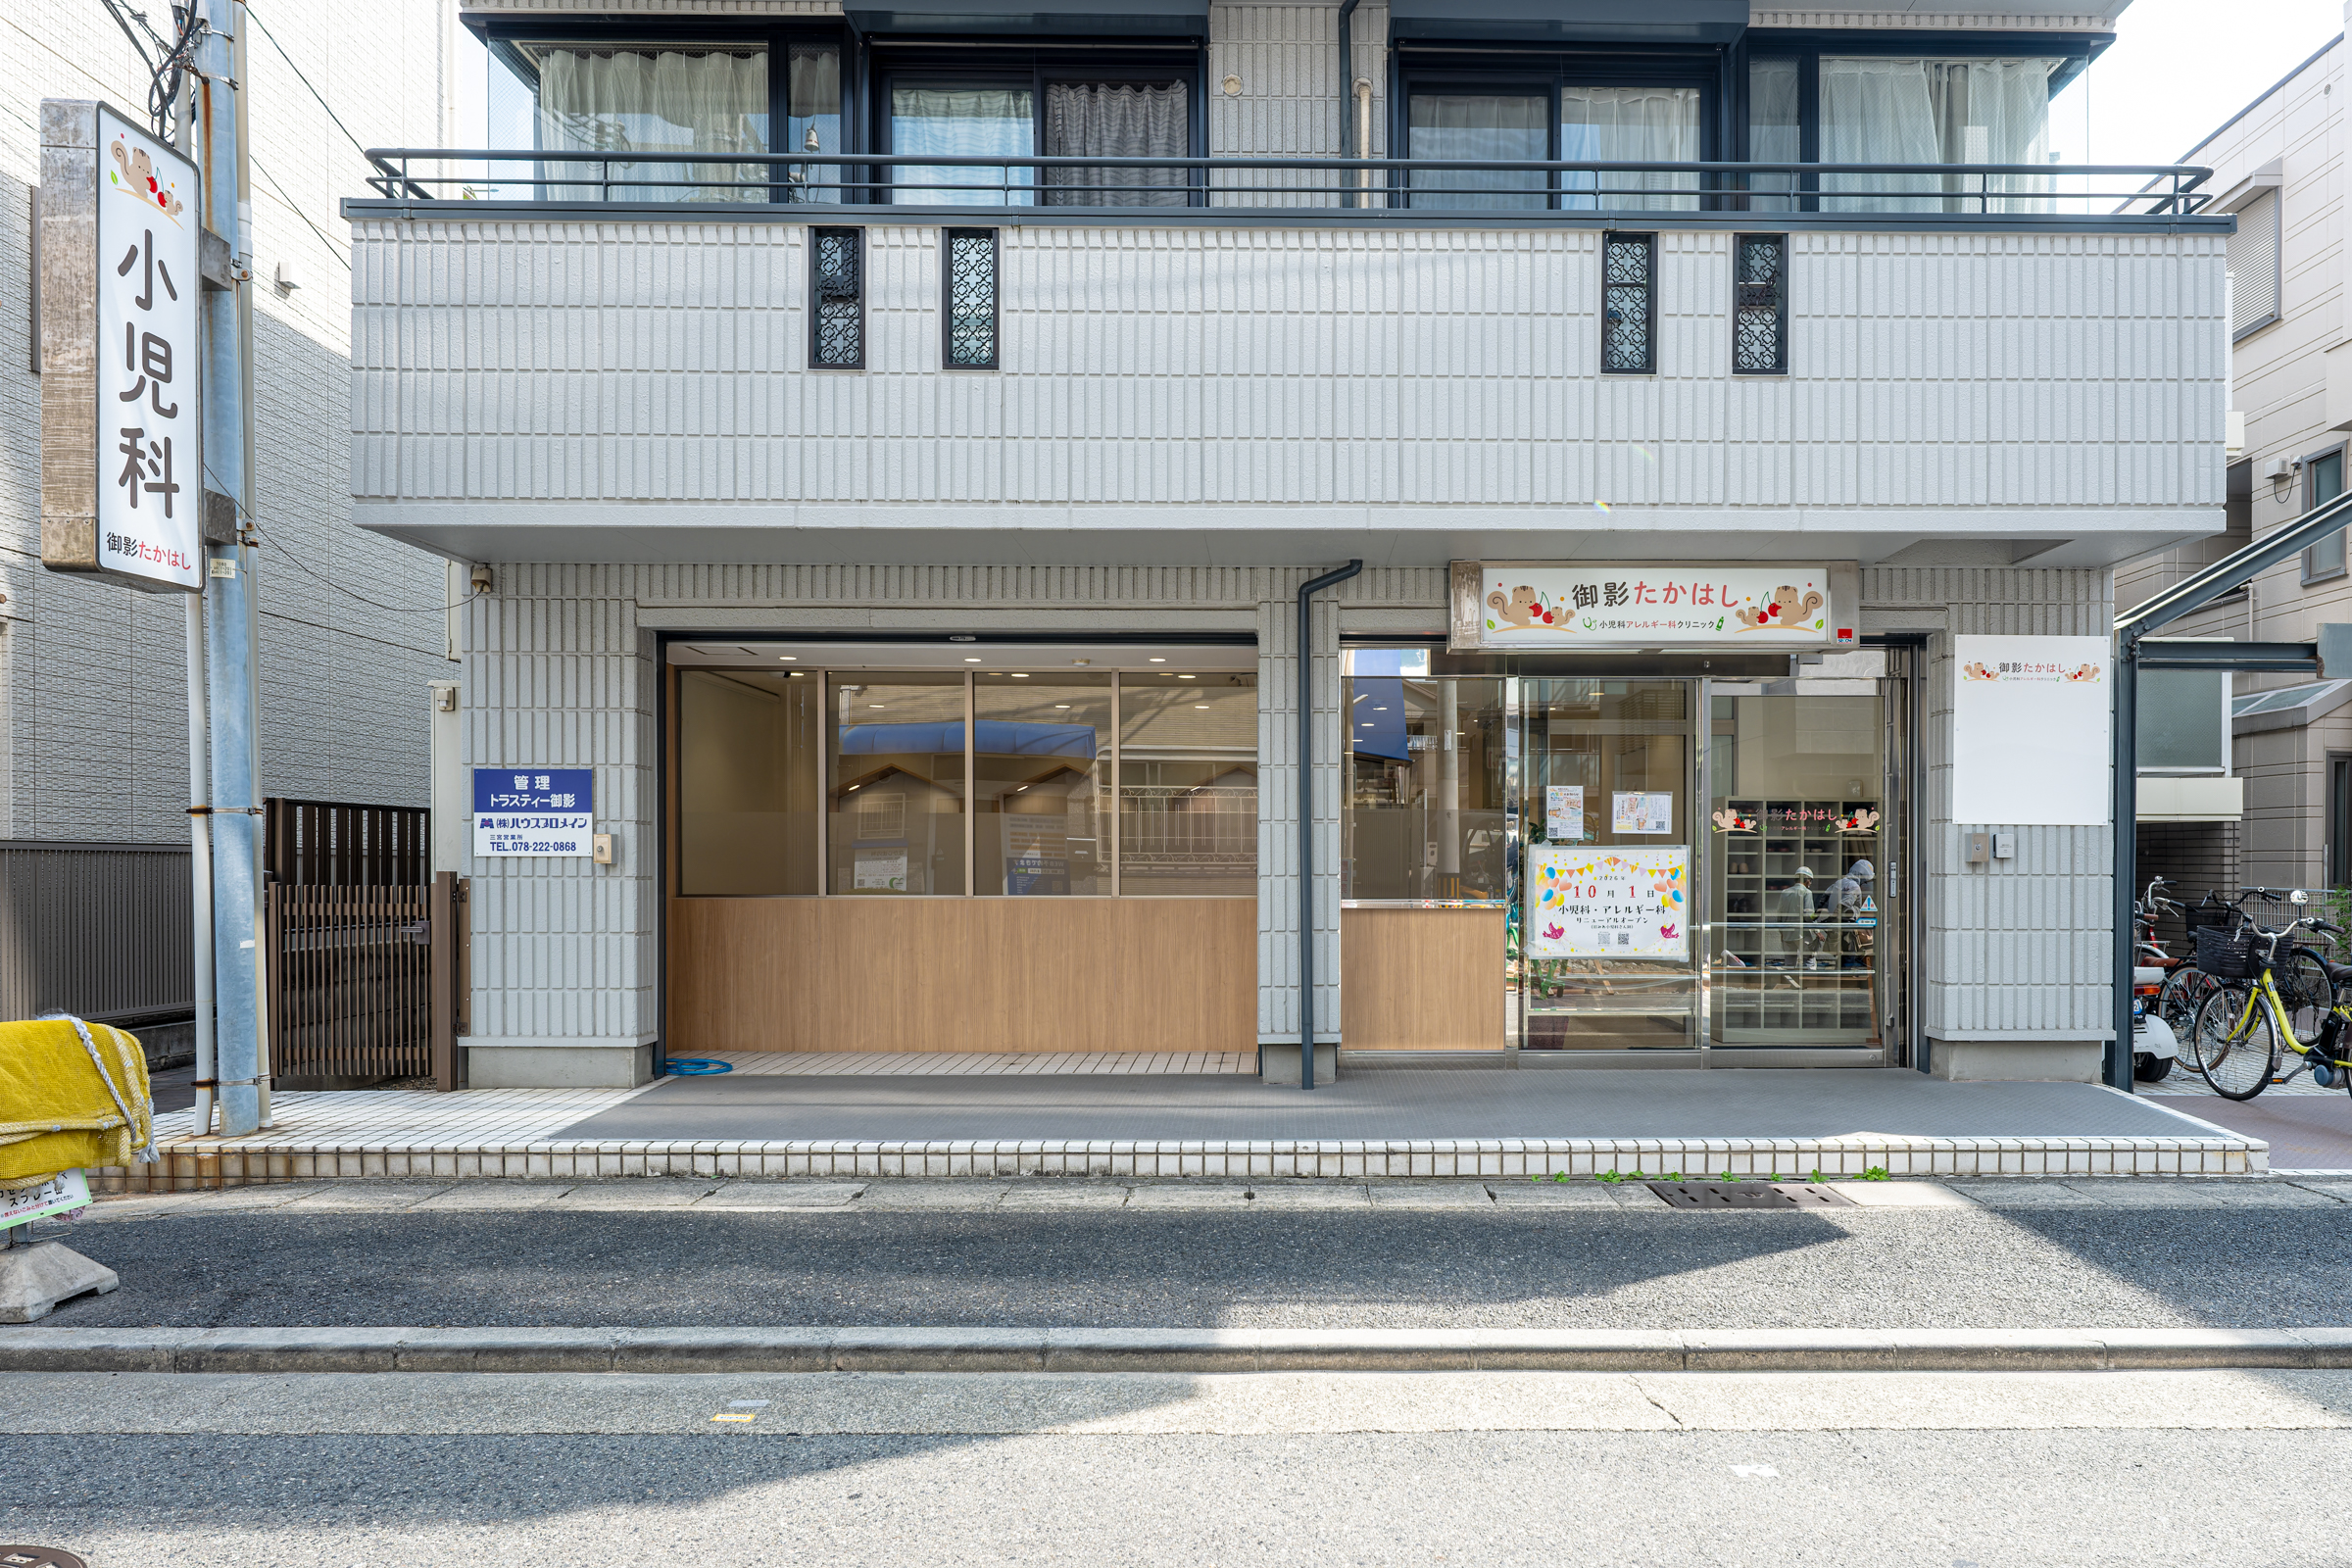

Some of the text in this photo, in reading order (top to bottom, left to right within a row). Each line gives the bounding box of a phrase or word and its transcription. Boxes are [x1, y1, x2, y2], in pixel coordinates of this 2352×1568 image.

[118, 228, 180, 519] 小児科
[106, 531, 192, 571] 御影たかはし
[1571, 580, 1739, 610] 御影たかはし
[1598, 619, 1715, 630] 小児科アレルギー科クリニック
[1998, 662, 2066, 673] 御影たかはし
[514, 774, 551, 790] 管理
[490, 793, 576, 808] トラスティー御影
[1755, 808, 1838, 821] 御影たかはし
[490, 841, 576, 852] TEL.078-222-0868
[1558, 905, 1666, 914] 小児科・アレルギー科
